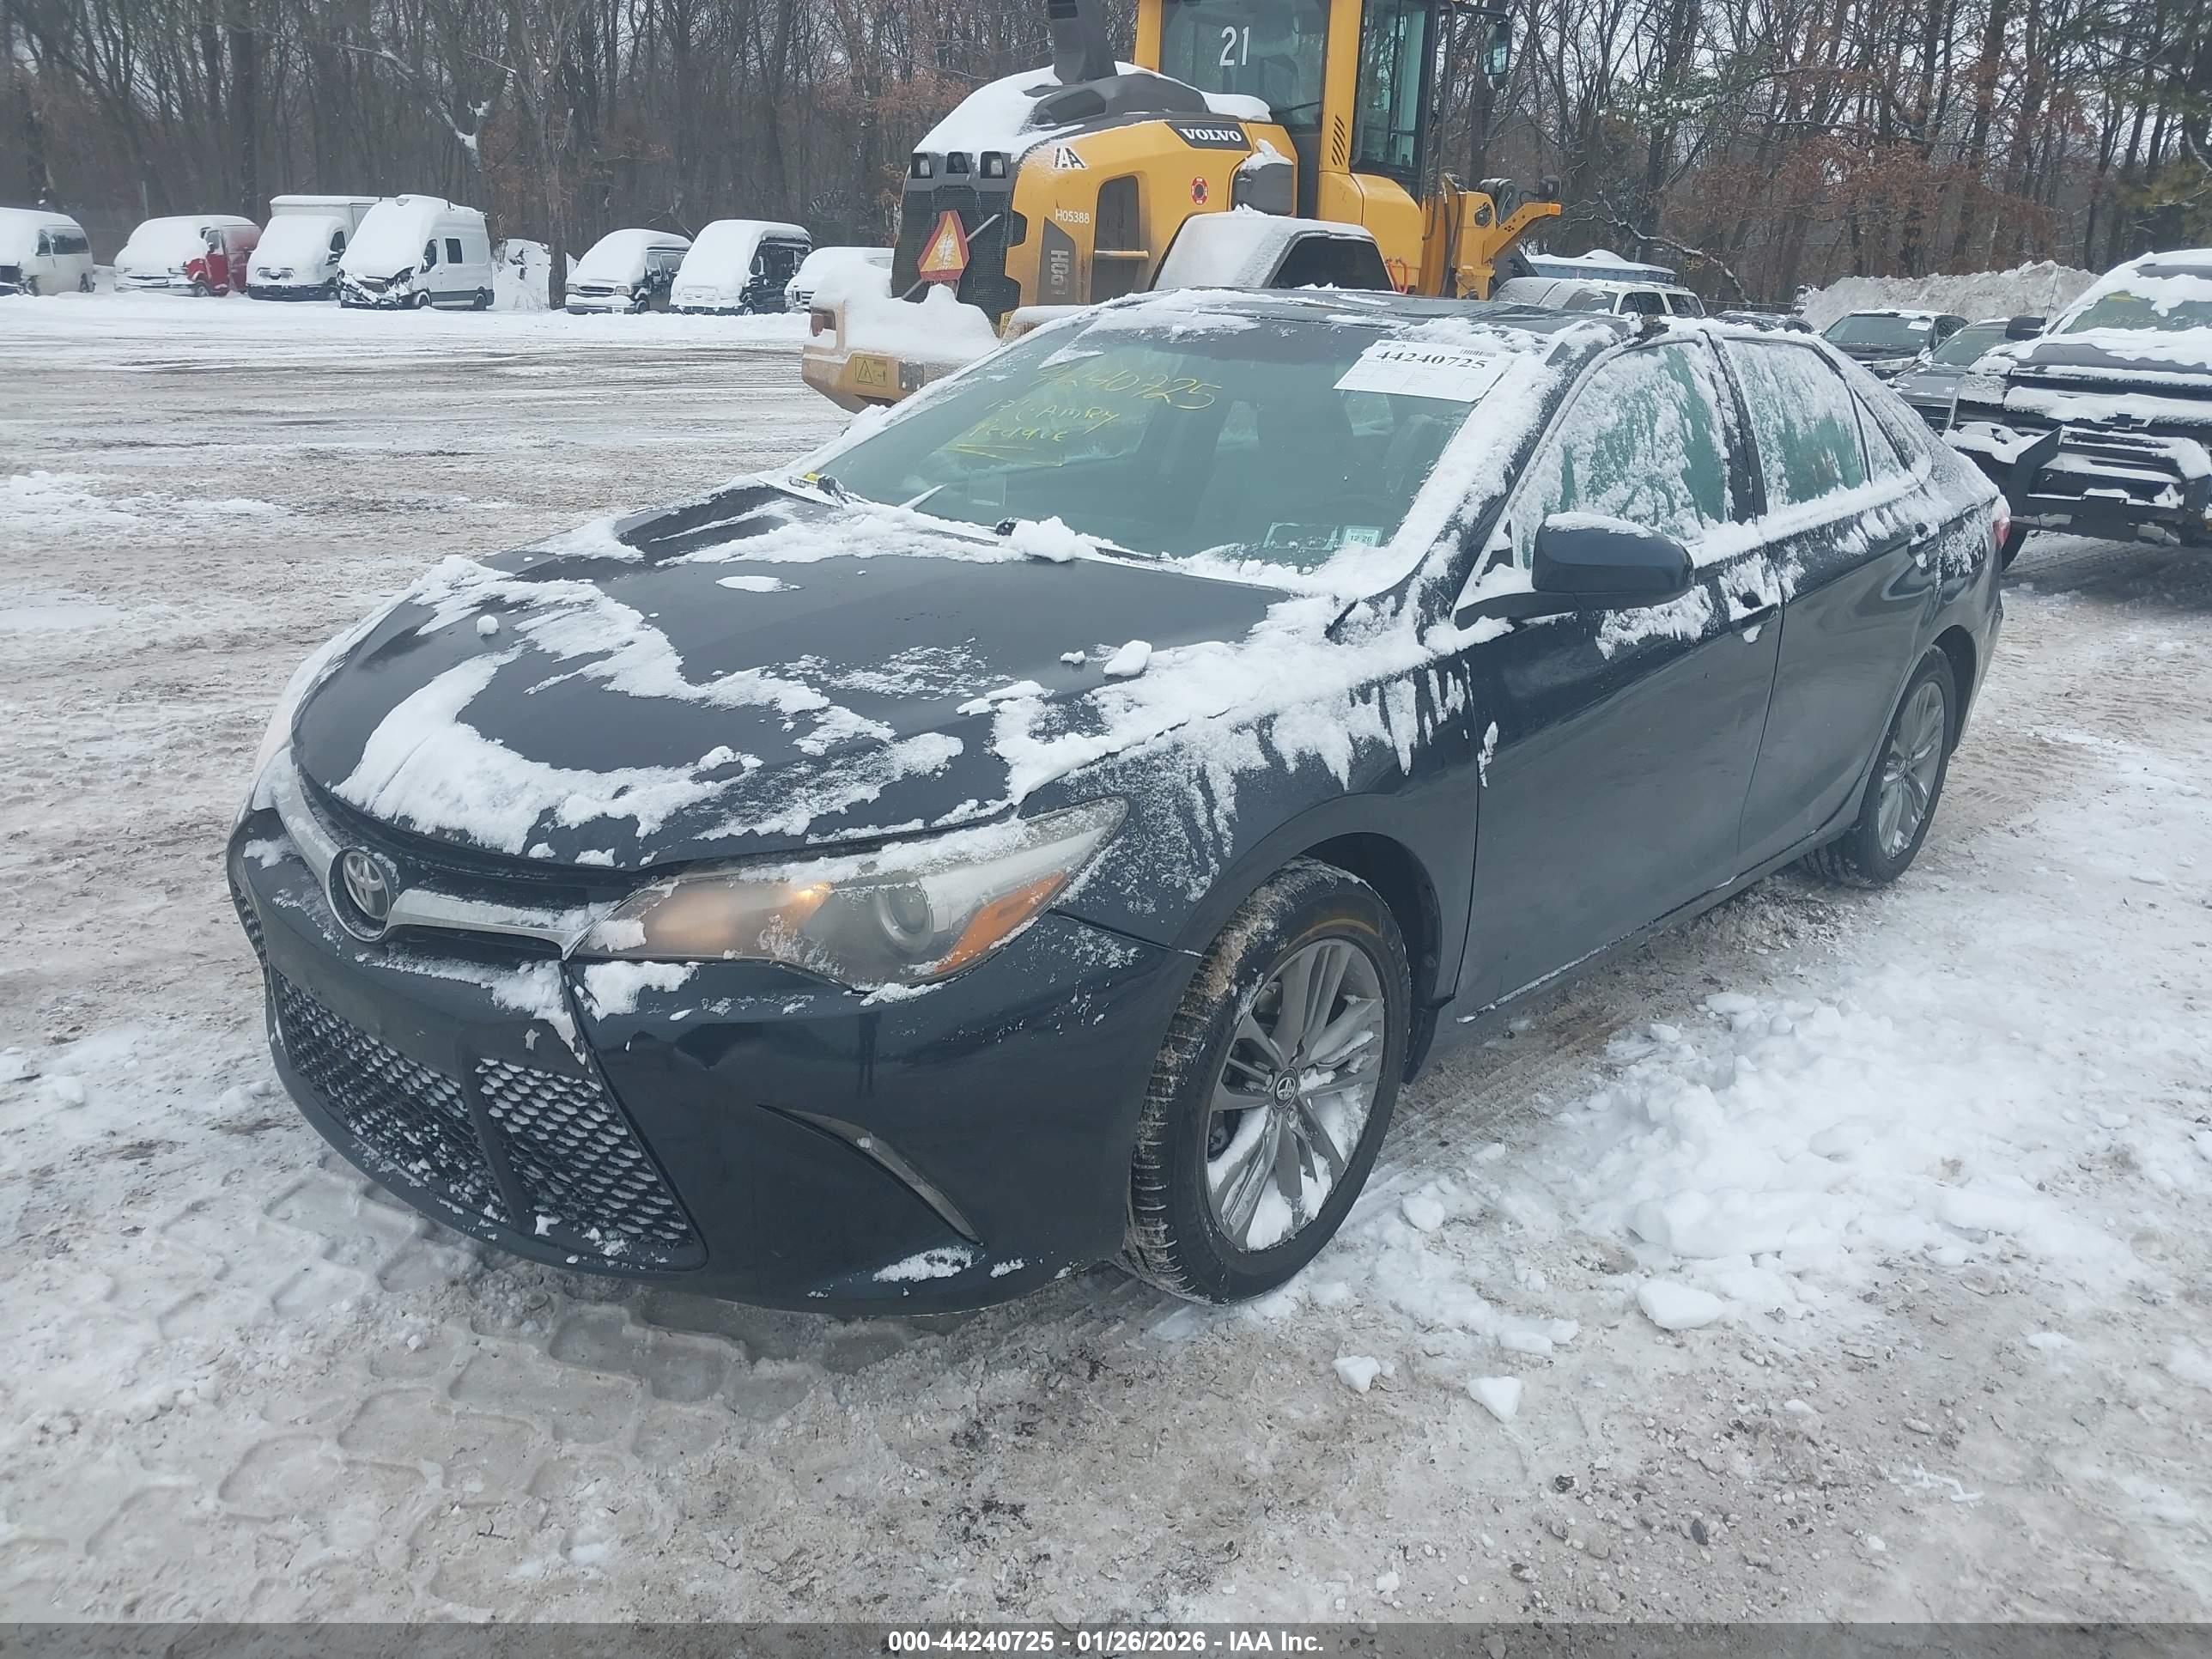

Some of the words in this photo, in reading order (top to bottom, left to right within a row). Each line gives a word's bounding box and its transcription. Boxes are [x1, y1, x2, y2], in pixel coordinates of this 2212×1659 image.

[1219, 26, 1249, 66] 21
[1179, 128, 1243, 143] VOLVO
[1055, 208, 1091, 224] H05388
[1376, 350, 1489, 370] 44240725
